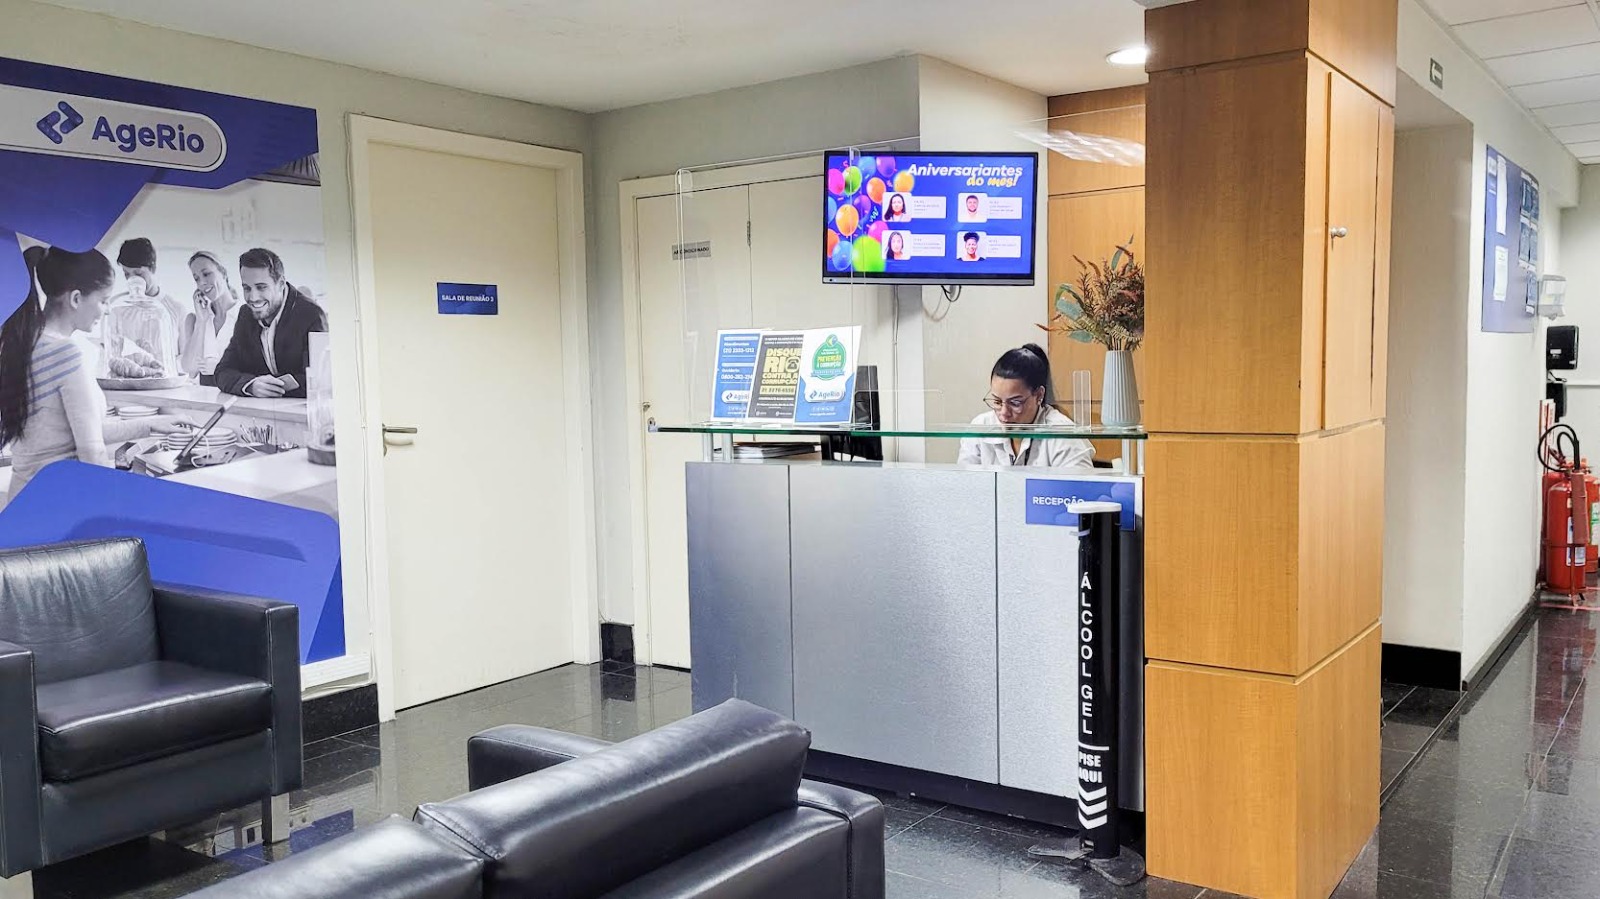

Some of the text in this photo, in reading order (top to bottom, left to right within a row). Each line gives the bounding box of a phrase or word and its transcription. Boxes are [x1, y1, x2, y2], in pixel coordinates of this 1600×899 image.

[92, 116, 205, 153] AgeRio
[907, 163, 1023, 176] Aniversariantes
[966, 174, 984, 186] do
[466, 294, 490, 302] REUNIÃO
[766, 347, 802, 357] DISQUE
[1080, 571, 1093, 678] ÁLCOOL
[1080, 684, 1093, 735] GEL
